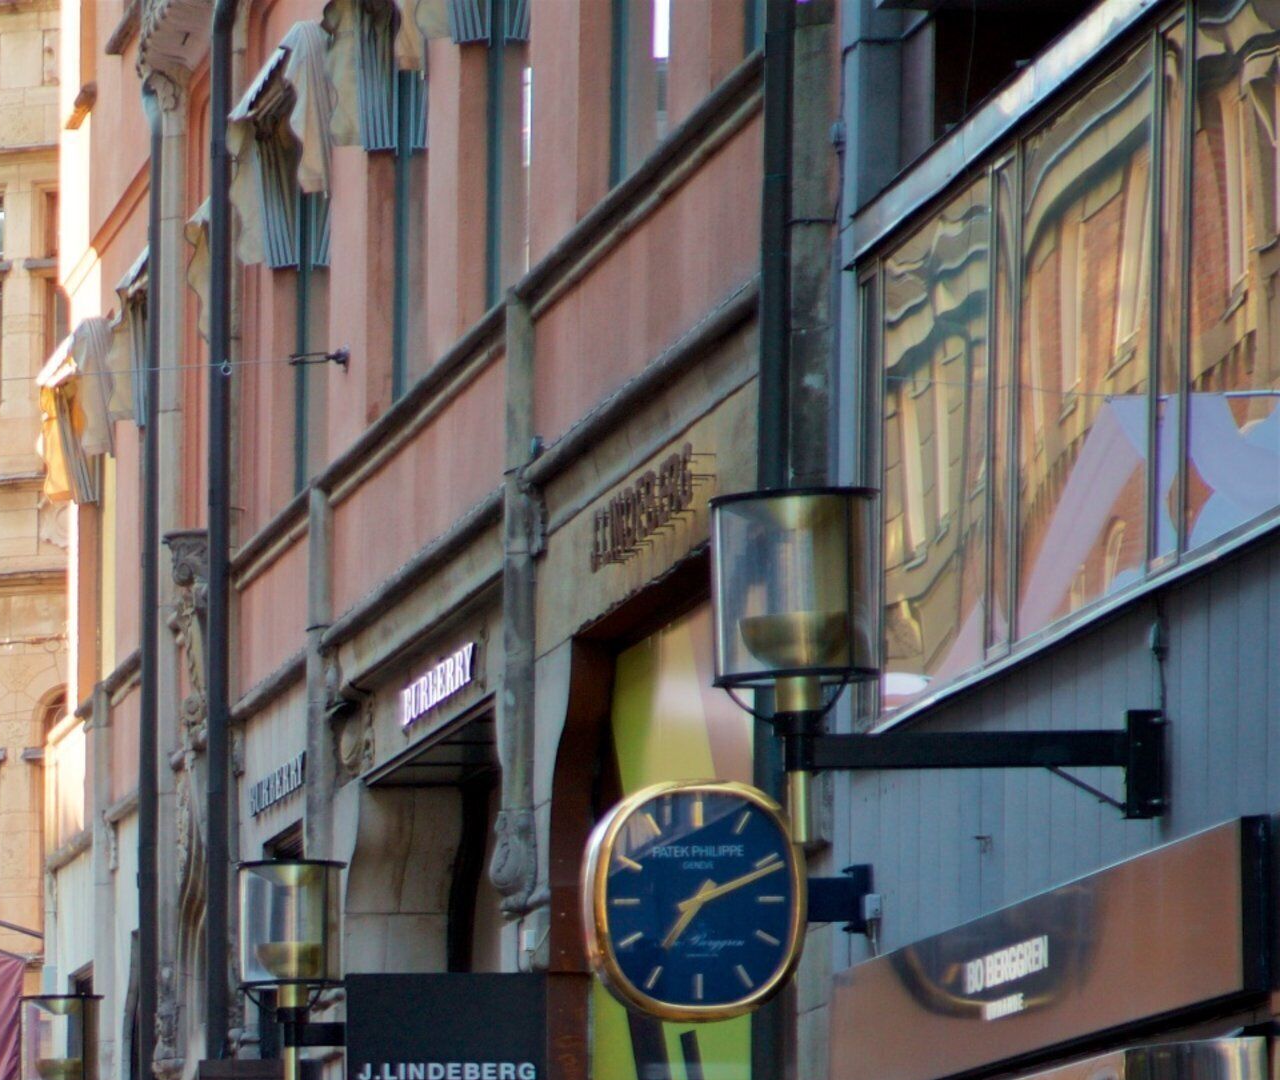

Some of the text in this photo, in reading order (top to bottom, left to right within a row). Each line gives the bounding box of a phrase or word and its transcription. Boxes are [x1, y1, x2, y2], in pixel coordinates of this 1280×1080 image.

[402, 642, 474, 726] BURBERRY
[651, 844, 744, 858] PATEK PHILIPPE
[965, 934, 1049, 994] BO BERGGREN
